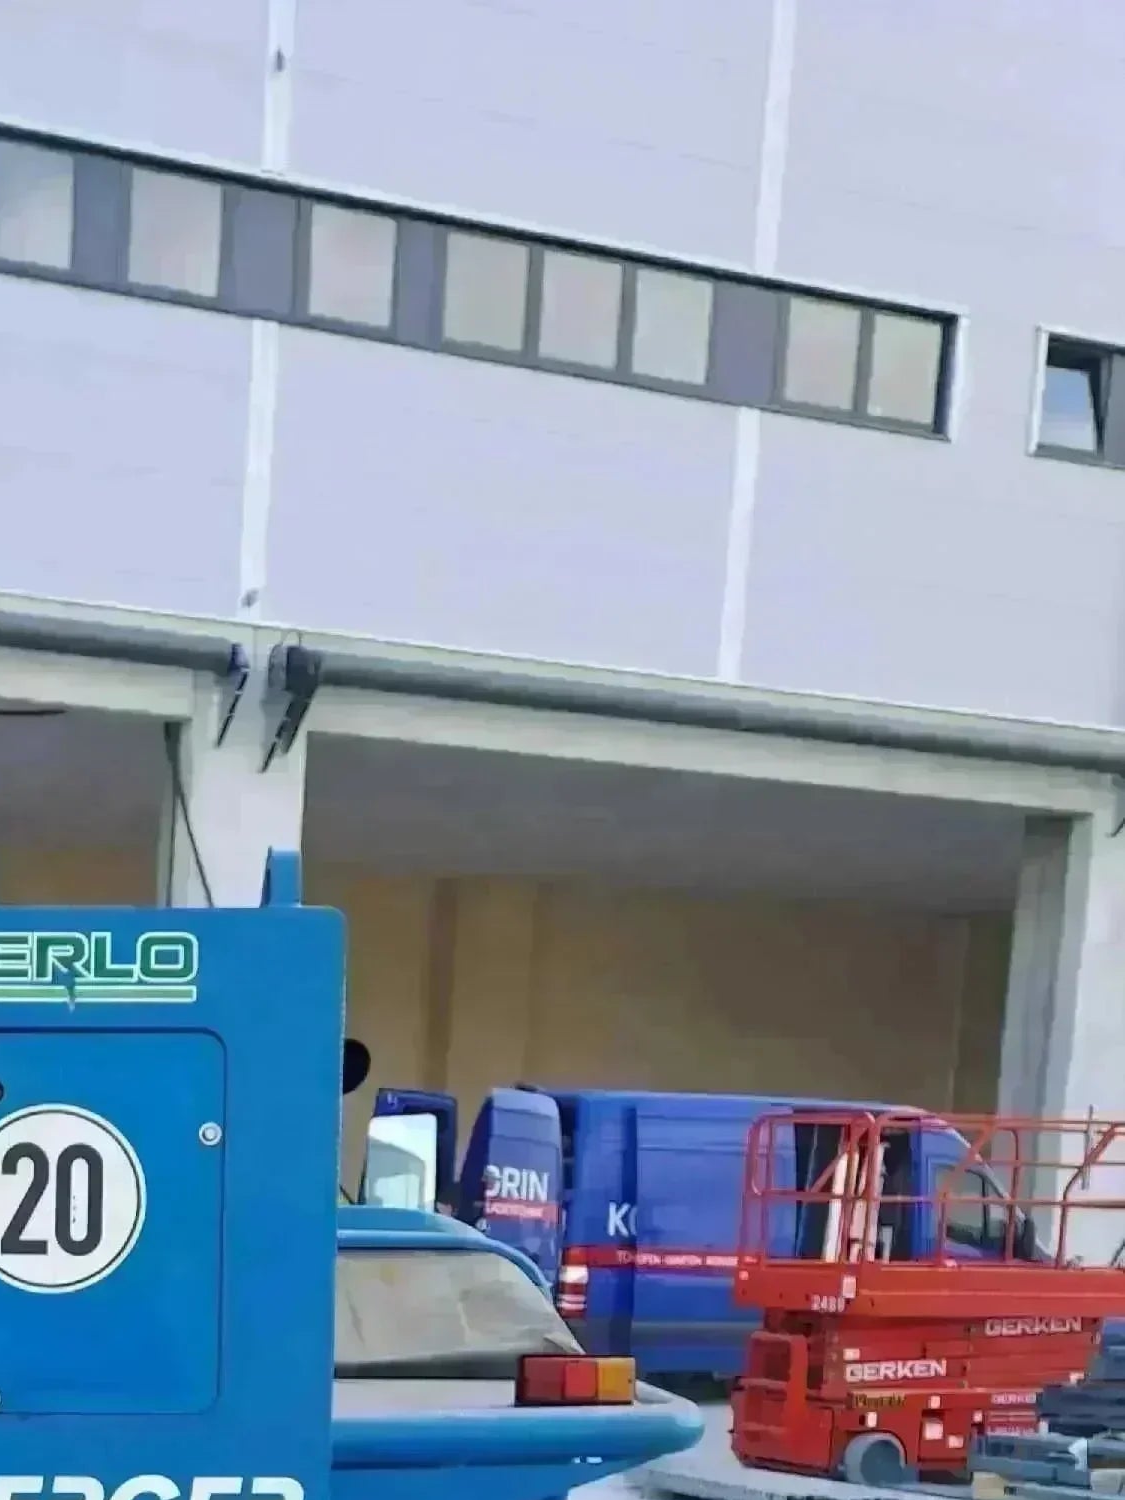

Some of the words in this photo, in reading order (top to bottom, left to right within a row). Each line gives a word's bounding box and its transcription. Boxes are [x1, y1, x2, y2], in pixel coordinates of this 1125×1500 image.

[0, 1142, 104, 1256] 20
[984, 1316, 1082, 1338] GERKEN
[845, 1359, 948, 1382] GERKEN
